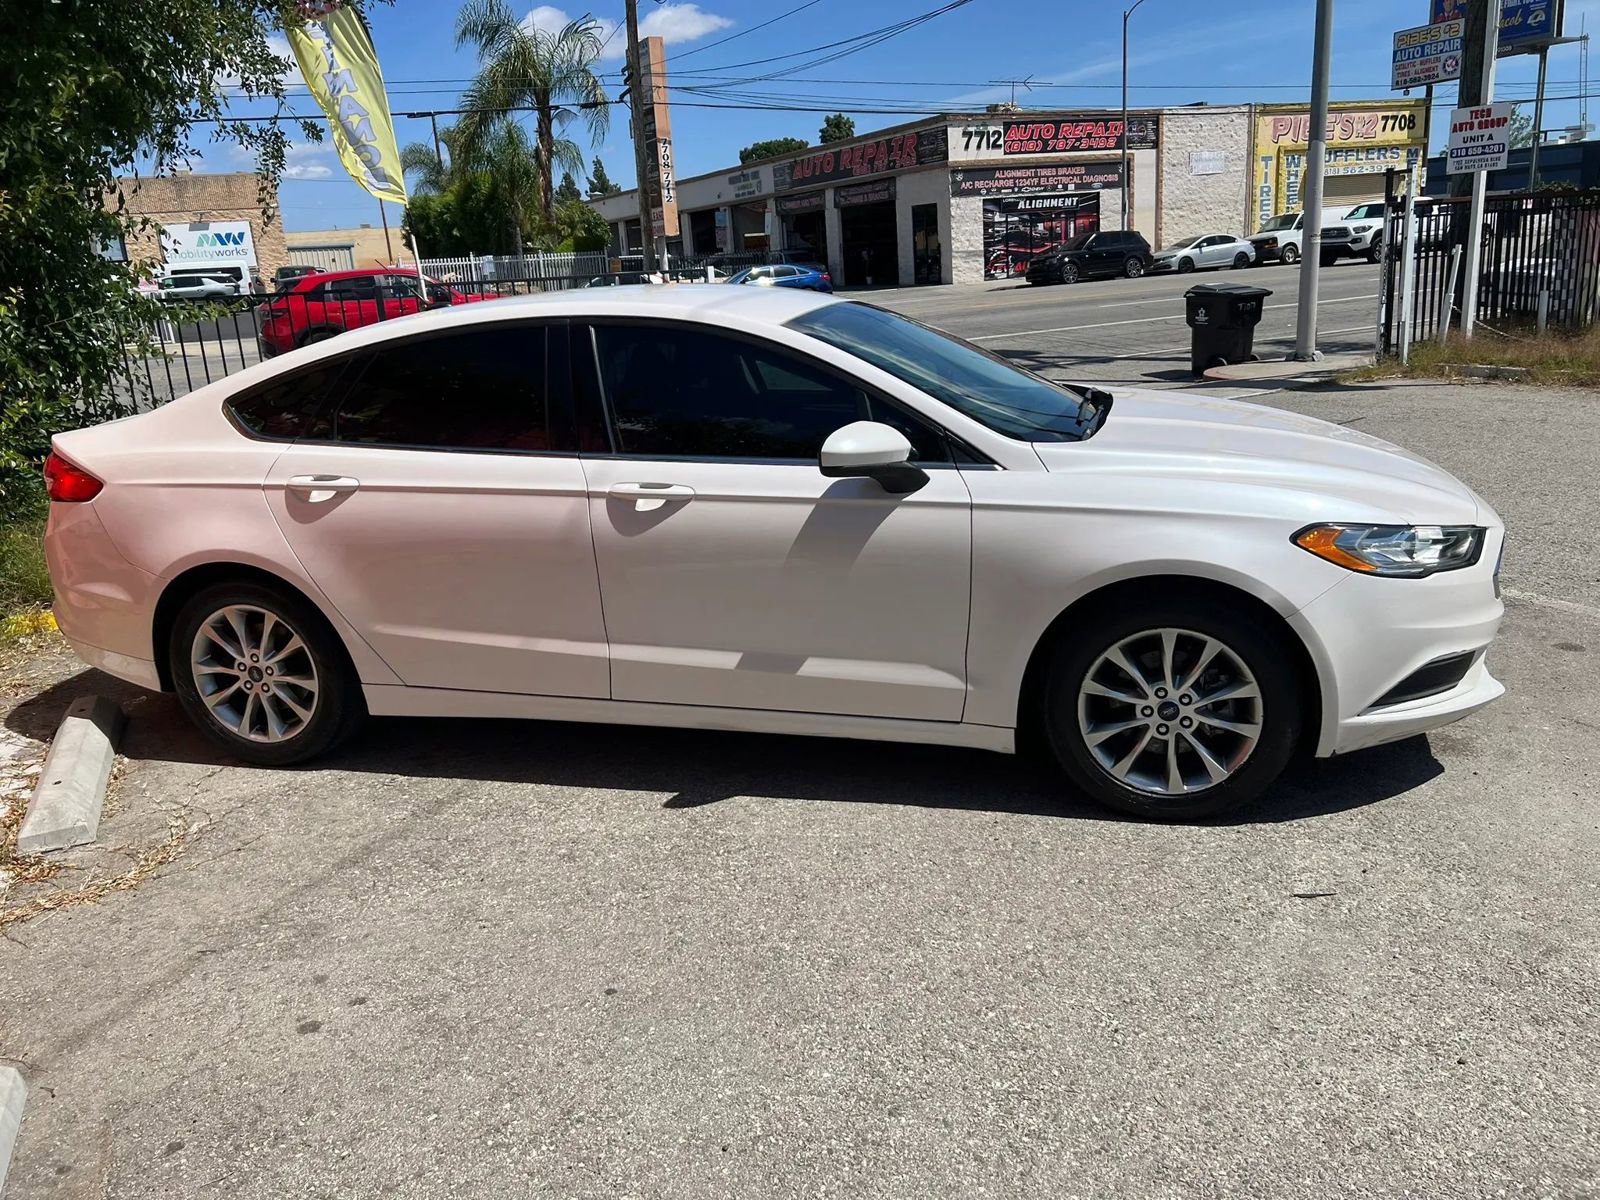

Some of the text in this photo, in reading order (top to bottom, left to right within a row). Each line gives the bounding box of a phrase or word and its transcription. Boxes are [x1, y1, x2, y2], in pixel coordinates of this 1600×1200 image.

[1397, 27, 1441, 48] PIBE'S
[1396, 38, 1461, 61] AUTO REPAIR
[1470, 108, 1492, 120] TECH
[1381, 114, 1416, 133] 7708
[1452, 117, 1508, 133] AUTO GROUP
[961, 129, 1003, 151] 7712
[1005, 124, 1055, 141] AUTO
[1462, 133, 1494, 143] UNIT A
[661, 138, 671, 169] 7708
[1004, 137, 1117, 153] (818) 787-3492
[792, 152, 835, 180] AUTO
[840, 134, 918, 170] REPAIR
[1324, 146, 1400, 164] UFFLERS
[994, 166, 1086, 179] ALIGNMENT TIRES BRAKES
[1324, 167, 1340, 176] 818)
[663, 172, 673, 203] 7712
[960, 181, 974, 190] A/C
[974, 179, 1014, 189] RECHARGE
[1015, 178, 1040, 187] 1234YF
[1040, 176, 1082, 186] ELECTRICAL
[1083, 174, 1119, 184] DIAGNOSIS
[1017, 197, 1079, 210] ALIGNMENT
